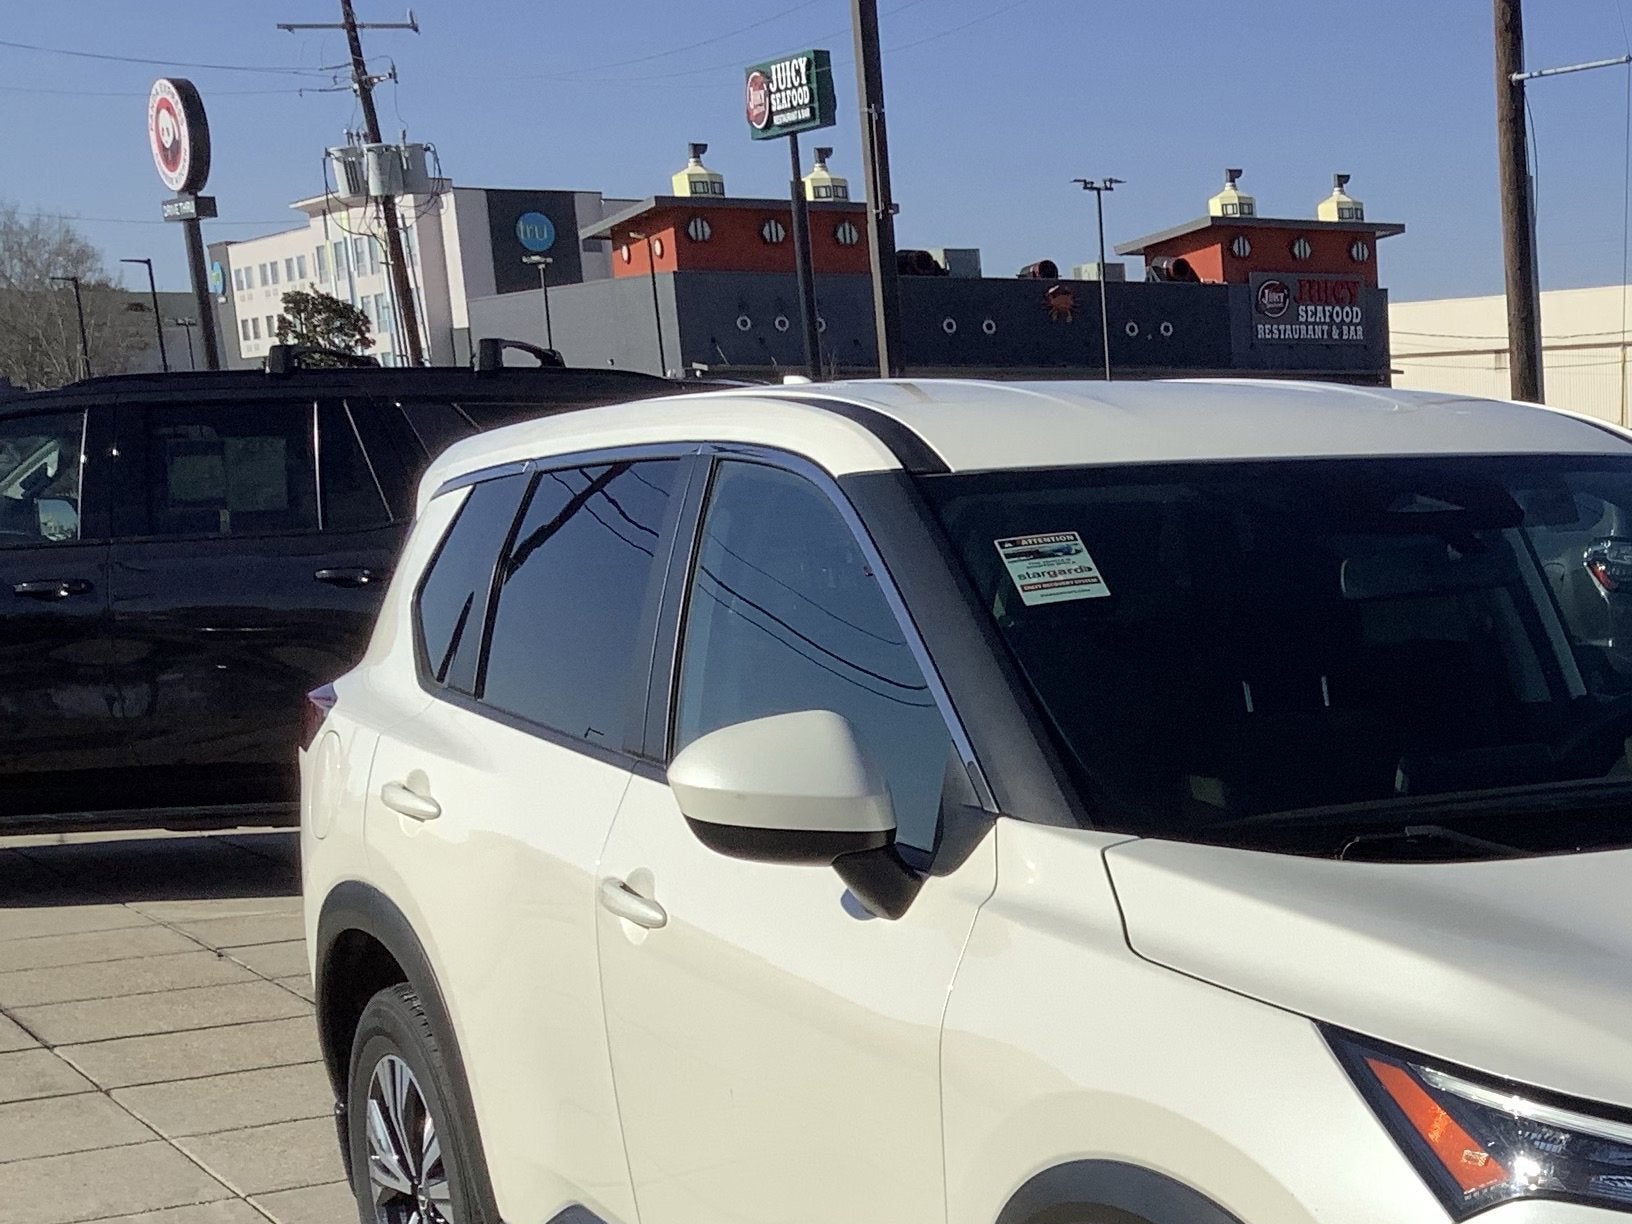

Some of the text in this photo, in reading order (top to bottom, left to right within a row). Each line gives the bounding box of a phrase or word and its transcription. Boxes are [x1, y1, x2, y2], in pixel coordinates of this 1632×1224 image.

[769, 57, 807, 92] JUICY
[770, 86, 810, 111] SEAFOOD
[516, 220, 548, 241] tru
[1295, 279, 1361, 304] JUICY
[1298, 305, 1361, 323] SEAFOOD
[1257, 324, 1364, 340] RESTAURANT & BAR
[1021, 533, 1075, 546] ATTENTION
